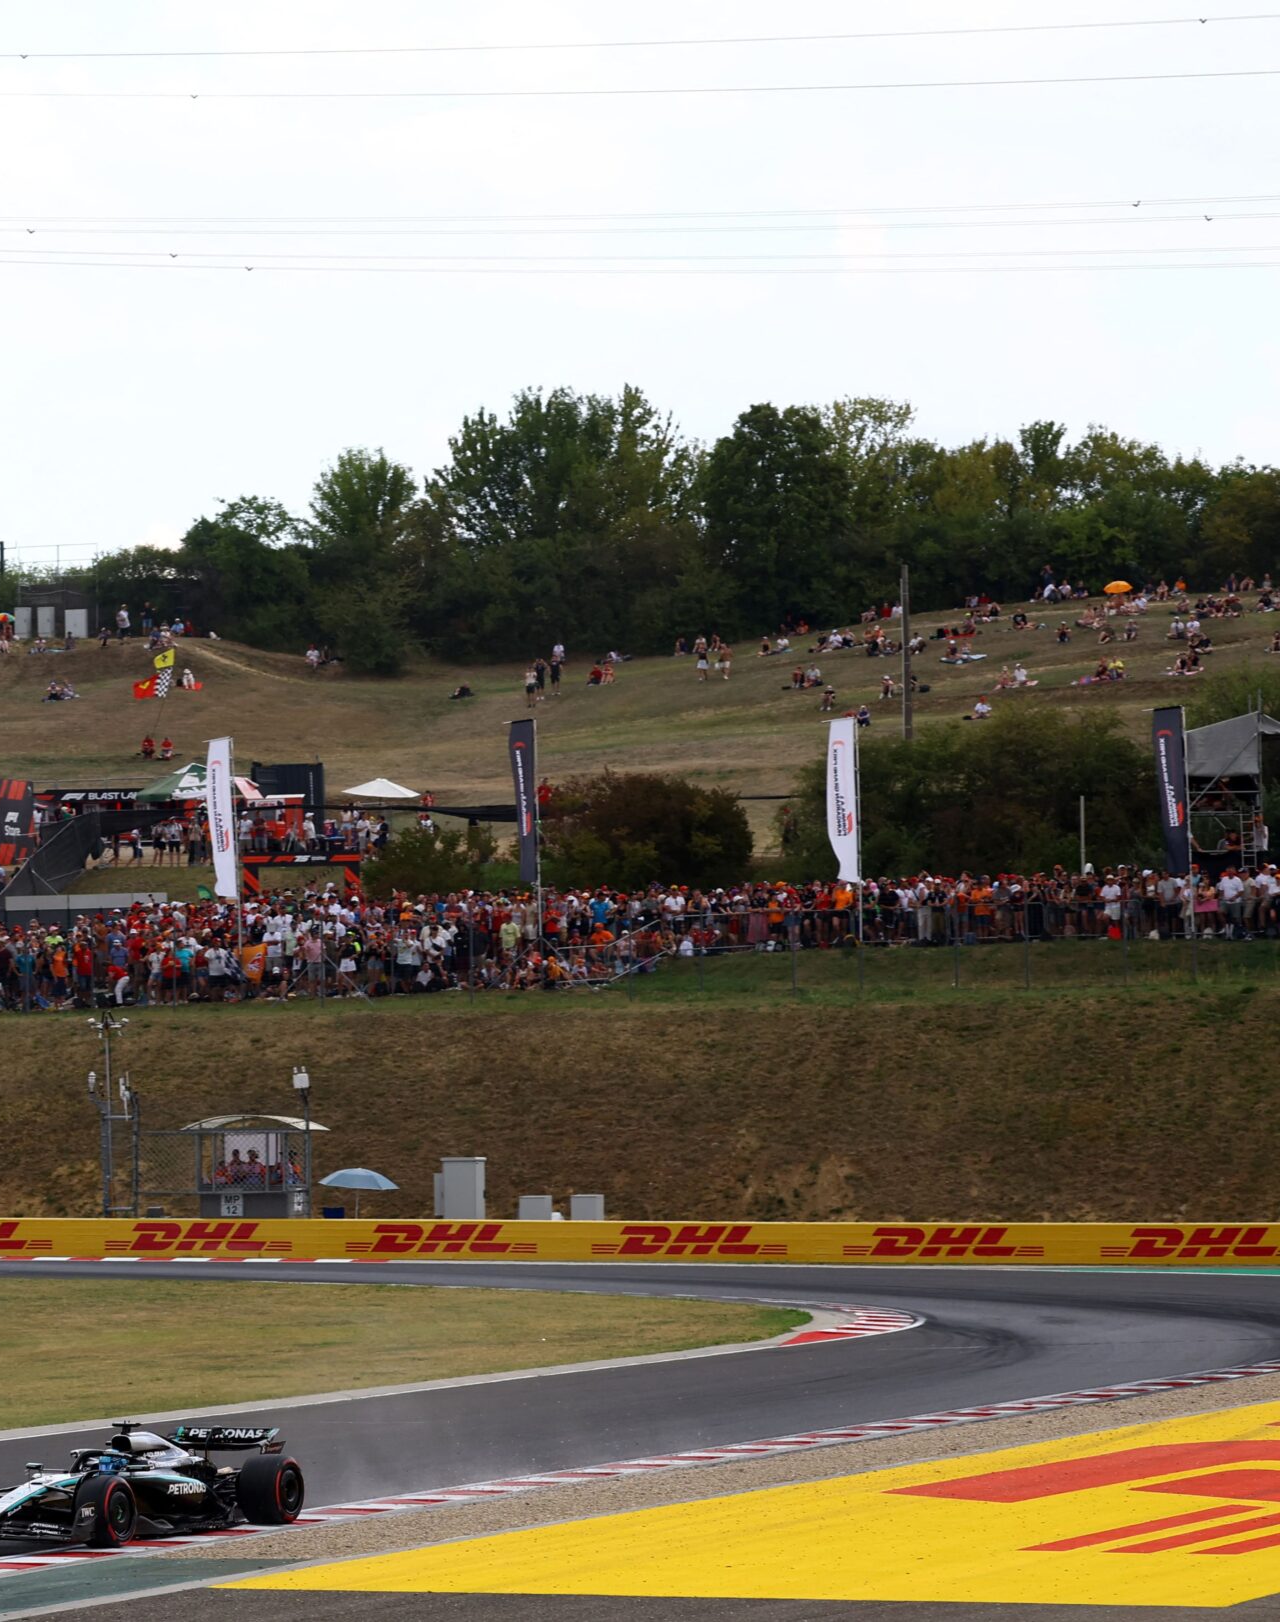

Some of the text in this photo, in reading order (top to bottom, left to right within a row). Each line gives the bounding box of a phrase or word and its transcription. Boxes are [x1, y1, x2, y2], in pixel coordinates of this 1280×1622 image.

[88, 792, 120, 800] BLAST
[224, 1195, 240, 1204] MP
[226, 1206, 238, 1215] 12
[130, 1222, 266, 1251] DHL
[371, 1224, 511, 1252] DHL
[617, 1225, 761, 1255] DHL
[870, 1226, 1018, 1257] DHL
[1128, 1227, 1279, 1258] DHL
[167, 1483, 206, 1495] PETRONAS
[81, 1506, 95, 1518] IWC
